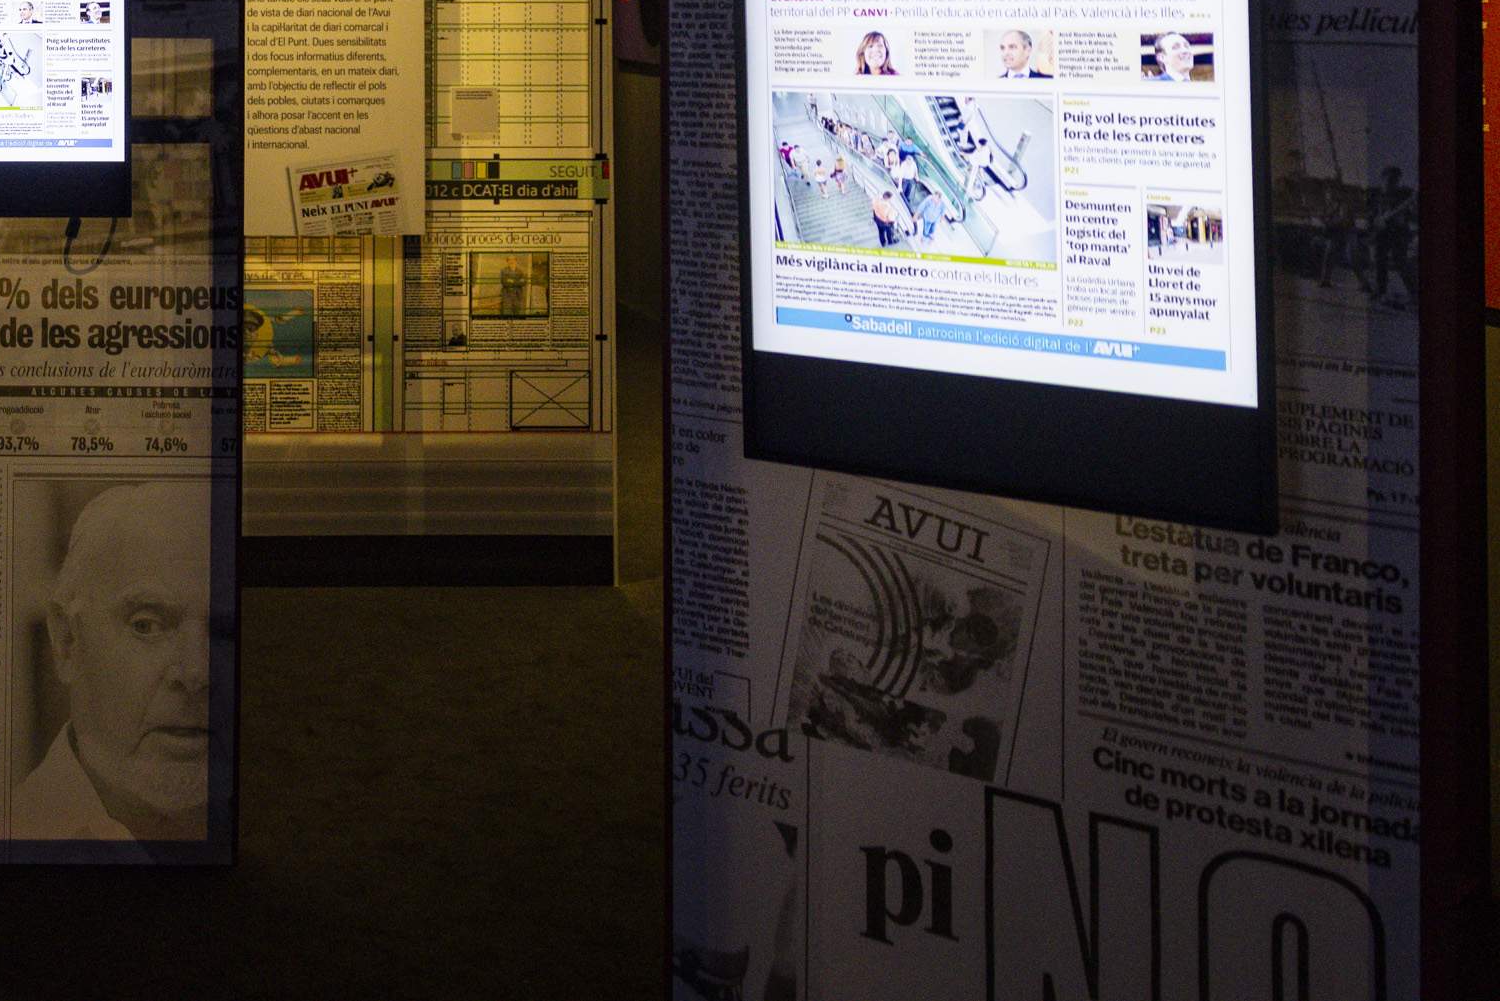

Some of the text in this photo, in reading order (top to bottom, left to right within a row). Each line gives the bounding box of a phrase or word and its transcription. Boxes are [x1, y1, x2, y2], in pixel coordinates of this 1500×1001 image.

[853, 8, 888, 17] CANVI
[296, 52, 344, 62] informatius
[1063, 112, 1216, 130] Puig vol les prostitutes
[252, 140, 310, 150] internacional.
[1134, 132, 1205, 145] carreteres
[302, 205, 328, 218] Neix
[1065, 200, 1131, 213] Desmunten
[776, 254, 929, 279] Més vigilància metro
[41, 278, 99, 309] dels
[110, 284, 239, 315] europeus
[1149, 305, 1210, 322] apunyalat
[0, 317, 240, 355] de les agressions
[851, 315, 972, 345] Sabadell patrocina
[10, 360, 94, 378] conclusions
[99, 360, 116, 377] de
[71, 436, 114, 452] 78,5%
[145, 436, 188, 452] 74,6%
[864, 494, 990, 563] AVUI
[1246, 538, 1409, 589] de Franco,
[1120, 545, 1402, 614] treta per voluntaris
[711, 764, 792, 811] ferits
[1093, 746, 1248, 804] Cinc morts
[1165, 799, 1390, 868] protesta xilena
[859, 828, 961, 946] pi
